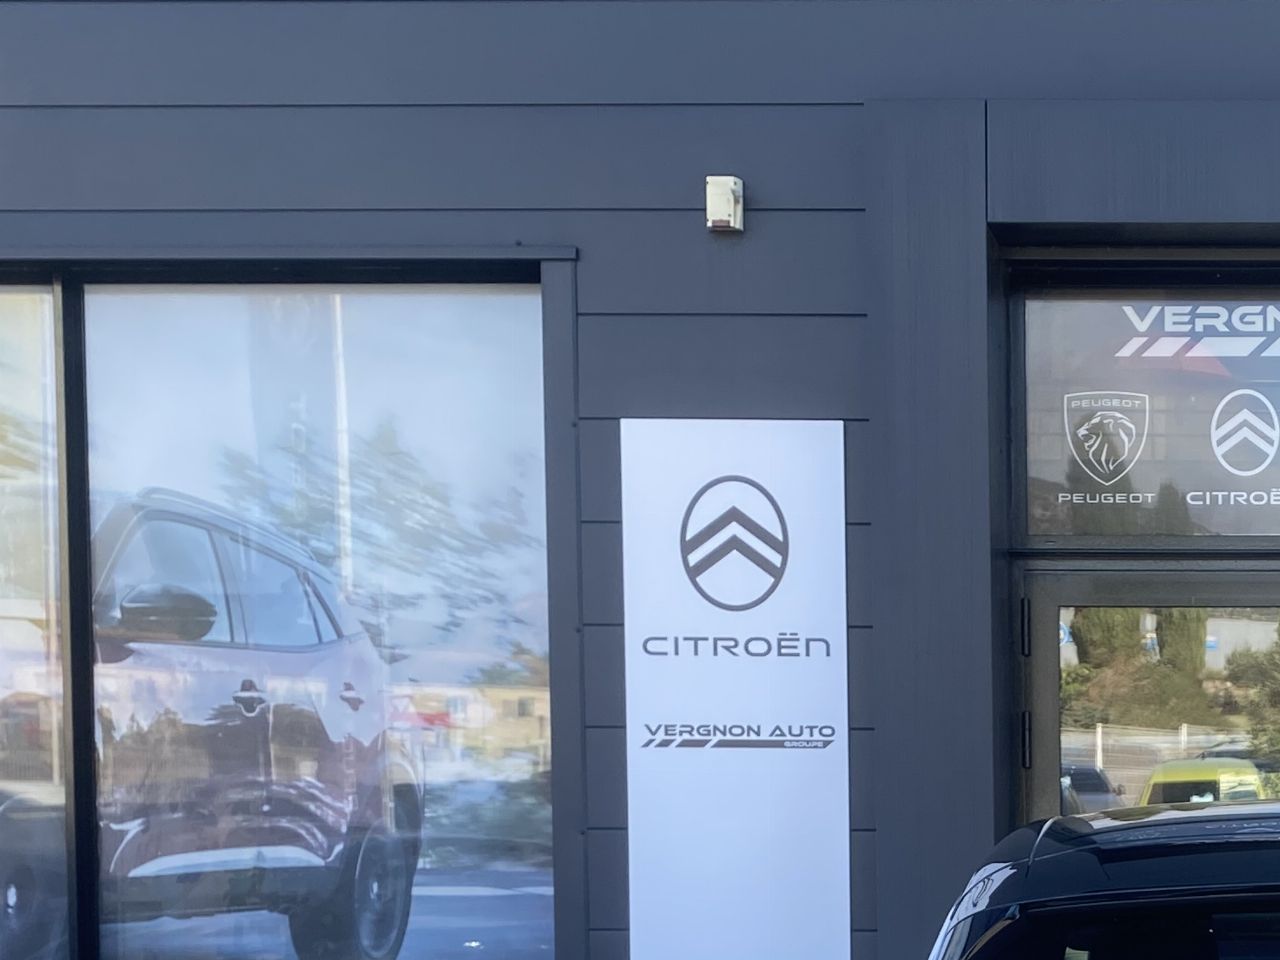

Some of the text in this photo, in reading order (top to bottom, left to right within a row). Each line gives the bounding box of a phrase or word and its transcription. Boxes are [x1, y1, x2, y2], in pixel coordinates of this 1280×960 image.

[1070, 398, 1142, 409] PEUGEOT
[1057, 492, 1156, 504] PEUGEOT
[642, 632, 832, 658] CITROËN
[644, 723, 837, 738] VERGNON AUTO
[783, 740, 825, 748] GROUPE
